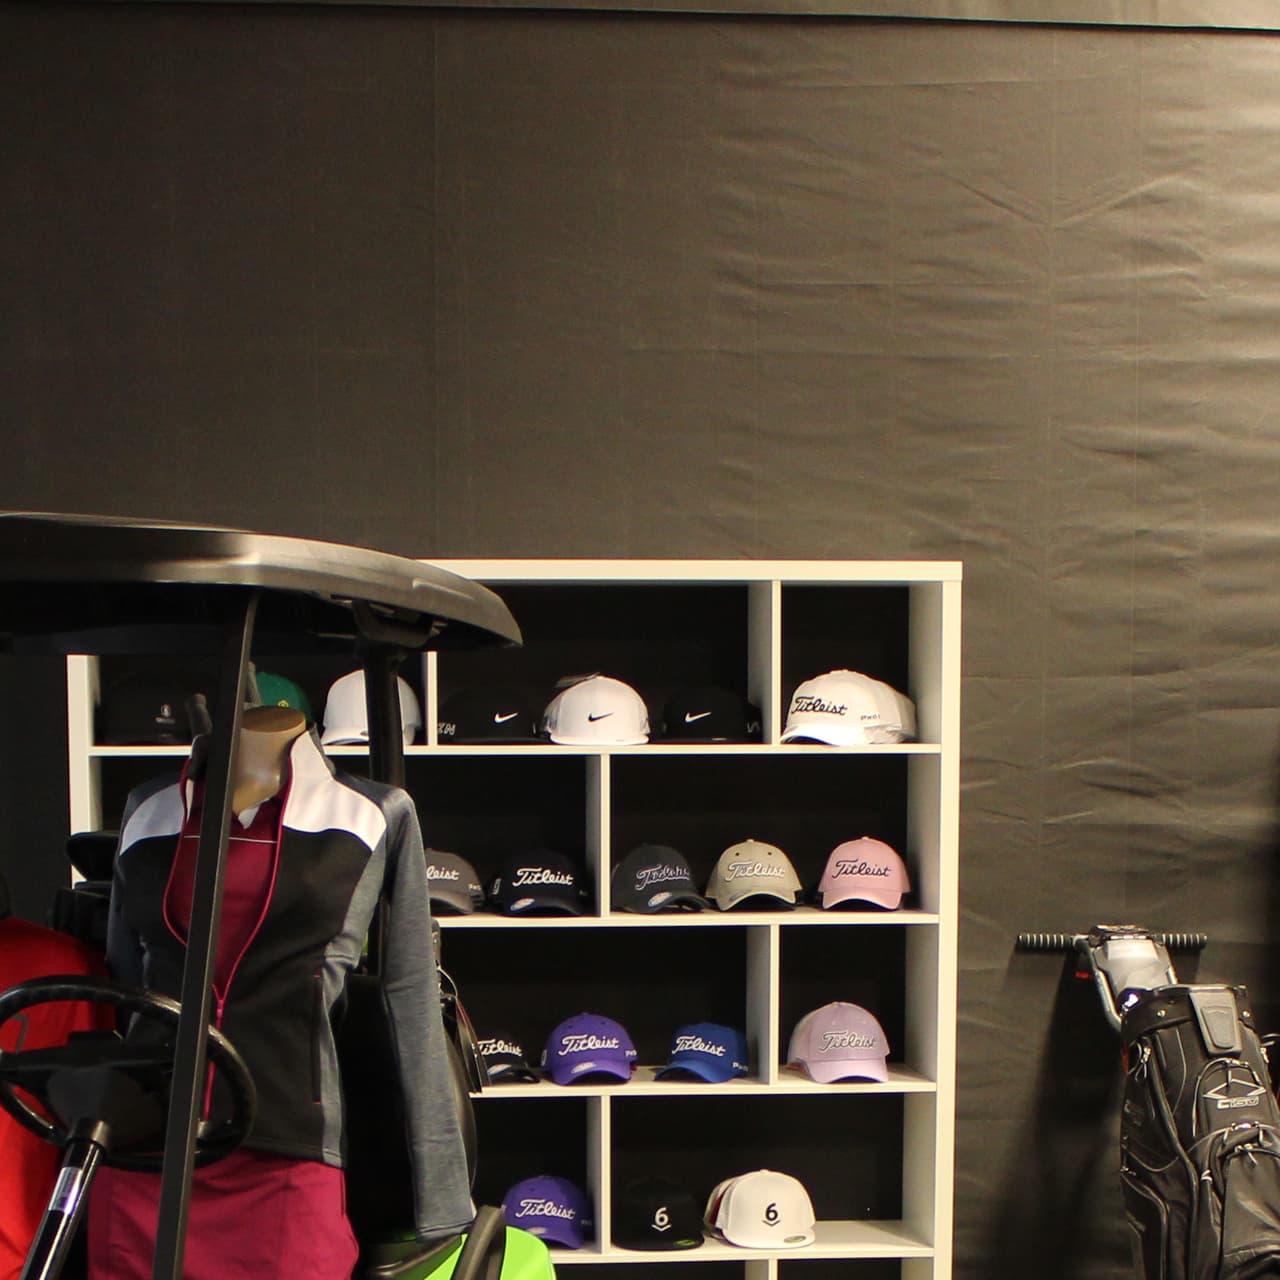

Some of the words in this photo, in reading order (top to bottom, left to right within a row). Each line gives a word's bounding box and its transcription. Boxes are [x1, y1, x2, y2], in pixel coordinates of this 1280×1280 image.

[791, 696, 848, 716] Titleist
[426, 865, 460, 881] leist
[512, 867, 573, 886] Titleist
[725, 860, 785, 883] Titleist
[831, 858, 892, 879] Titleist
[558, 1034, 620, 1056] Titleist
[672, 1035, 726, 1057] Titleist
[819, 1030, 877, 1051] Titleist
[515, 1199, 576, 1220] Titleist
[654, 1207, 669, 1225] 6
[765, 1202, 779, 1221] 6
